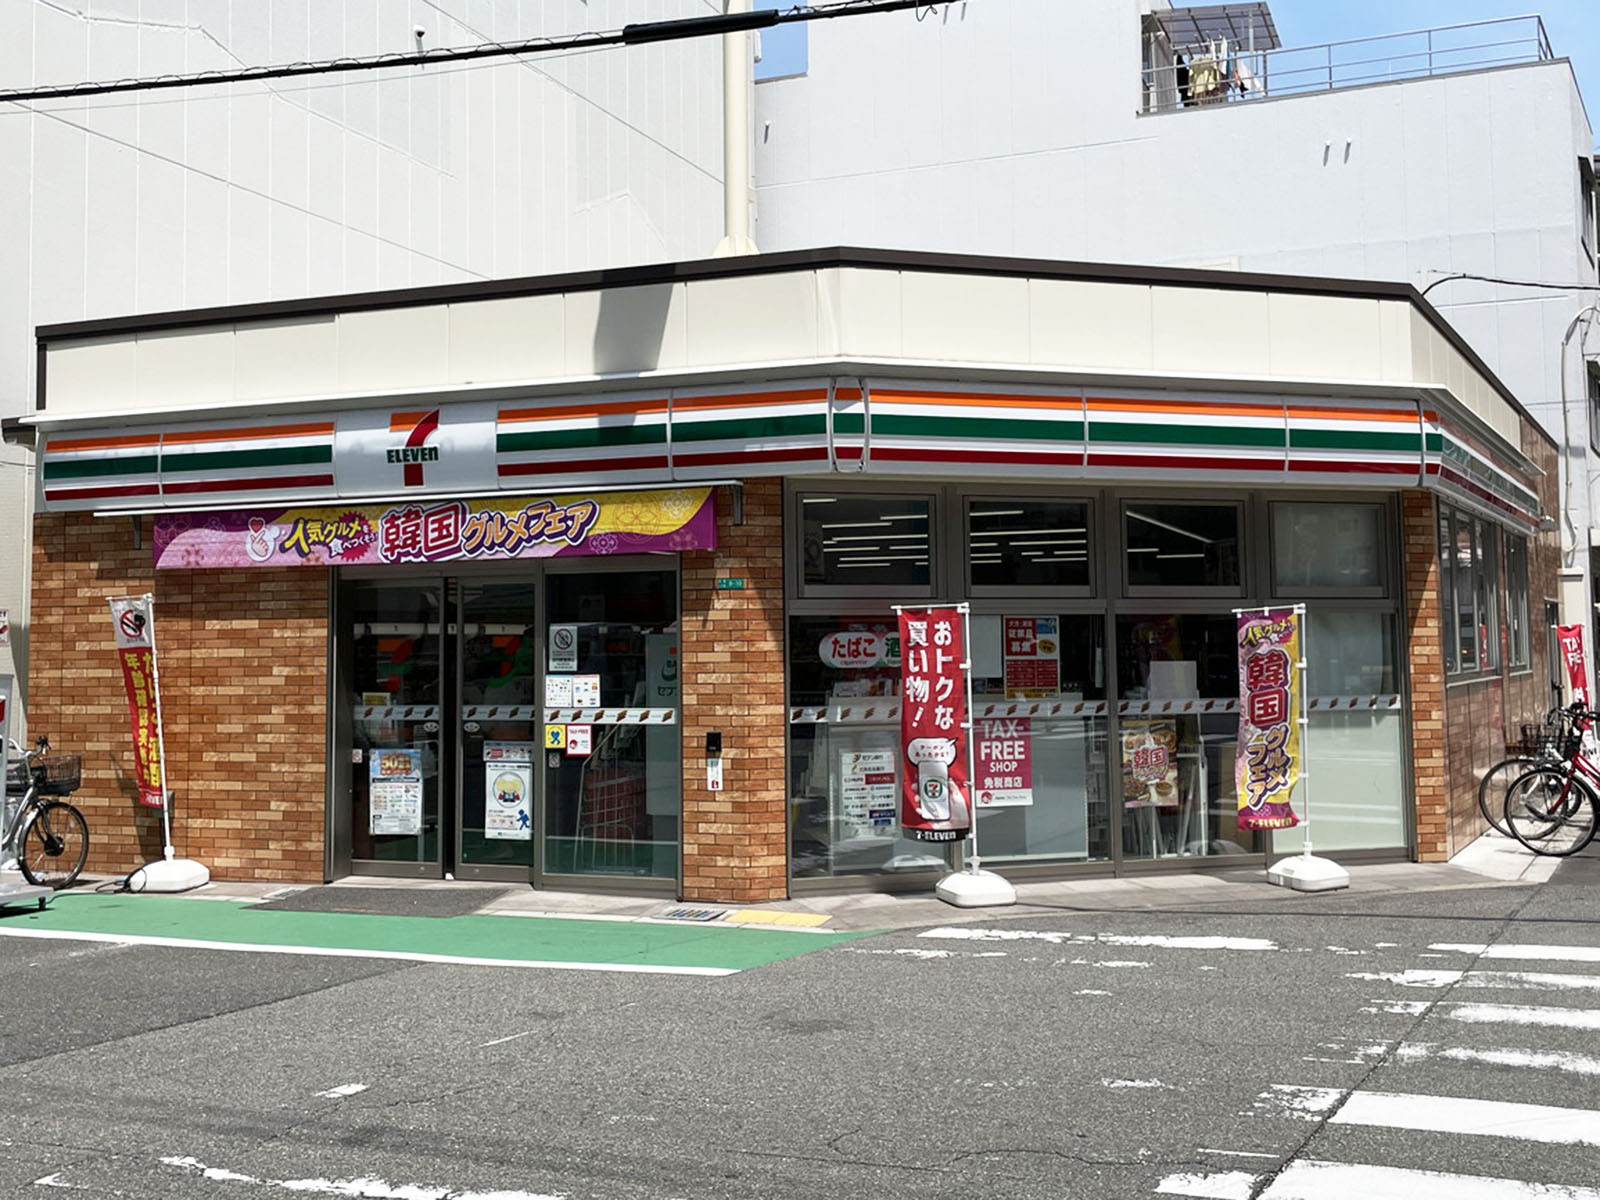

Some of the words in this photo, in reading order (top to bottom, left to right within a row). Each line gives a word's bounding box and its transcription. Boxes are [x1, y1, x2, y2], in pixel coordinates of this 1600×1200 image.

[832, 636, 877, 659] たばこ
[885, 637, 902, 658] 酒
[905, 620, 930, 728] 買い物!
[933, 620, 955, 730] おトクな
[1247, 651, 1287, 726] 韓国
[980, 740, 1026, 761] FREE
[989, 761, 1018, 773] SHOP
[1247, 744, 1267, 807] フェア
[1266, 727, 1288, 790] グルメ
